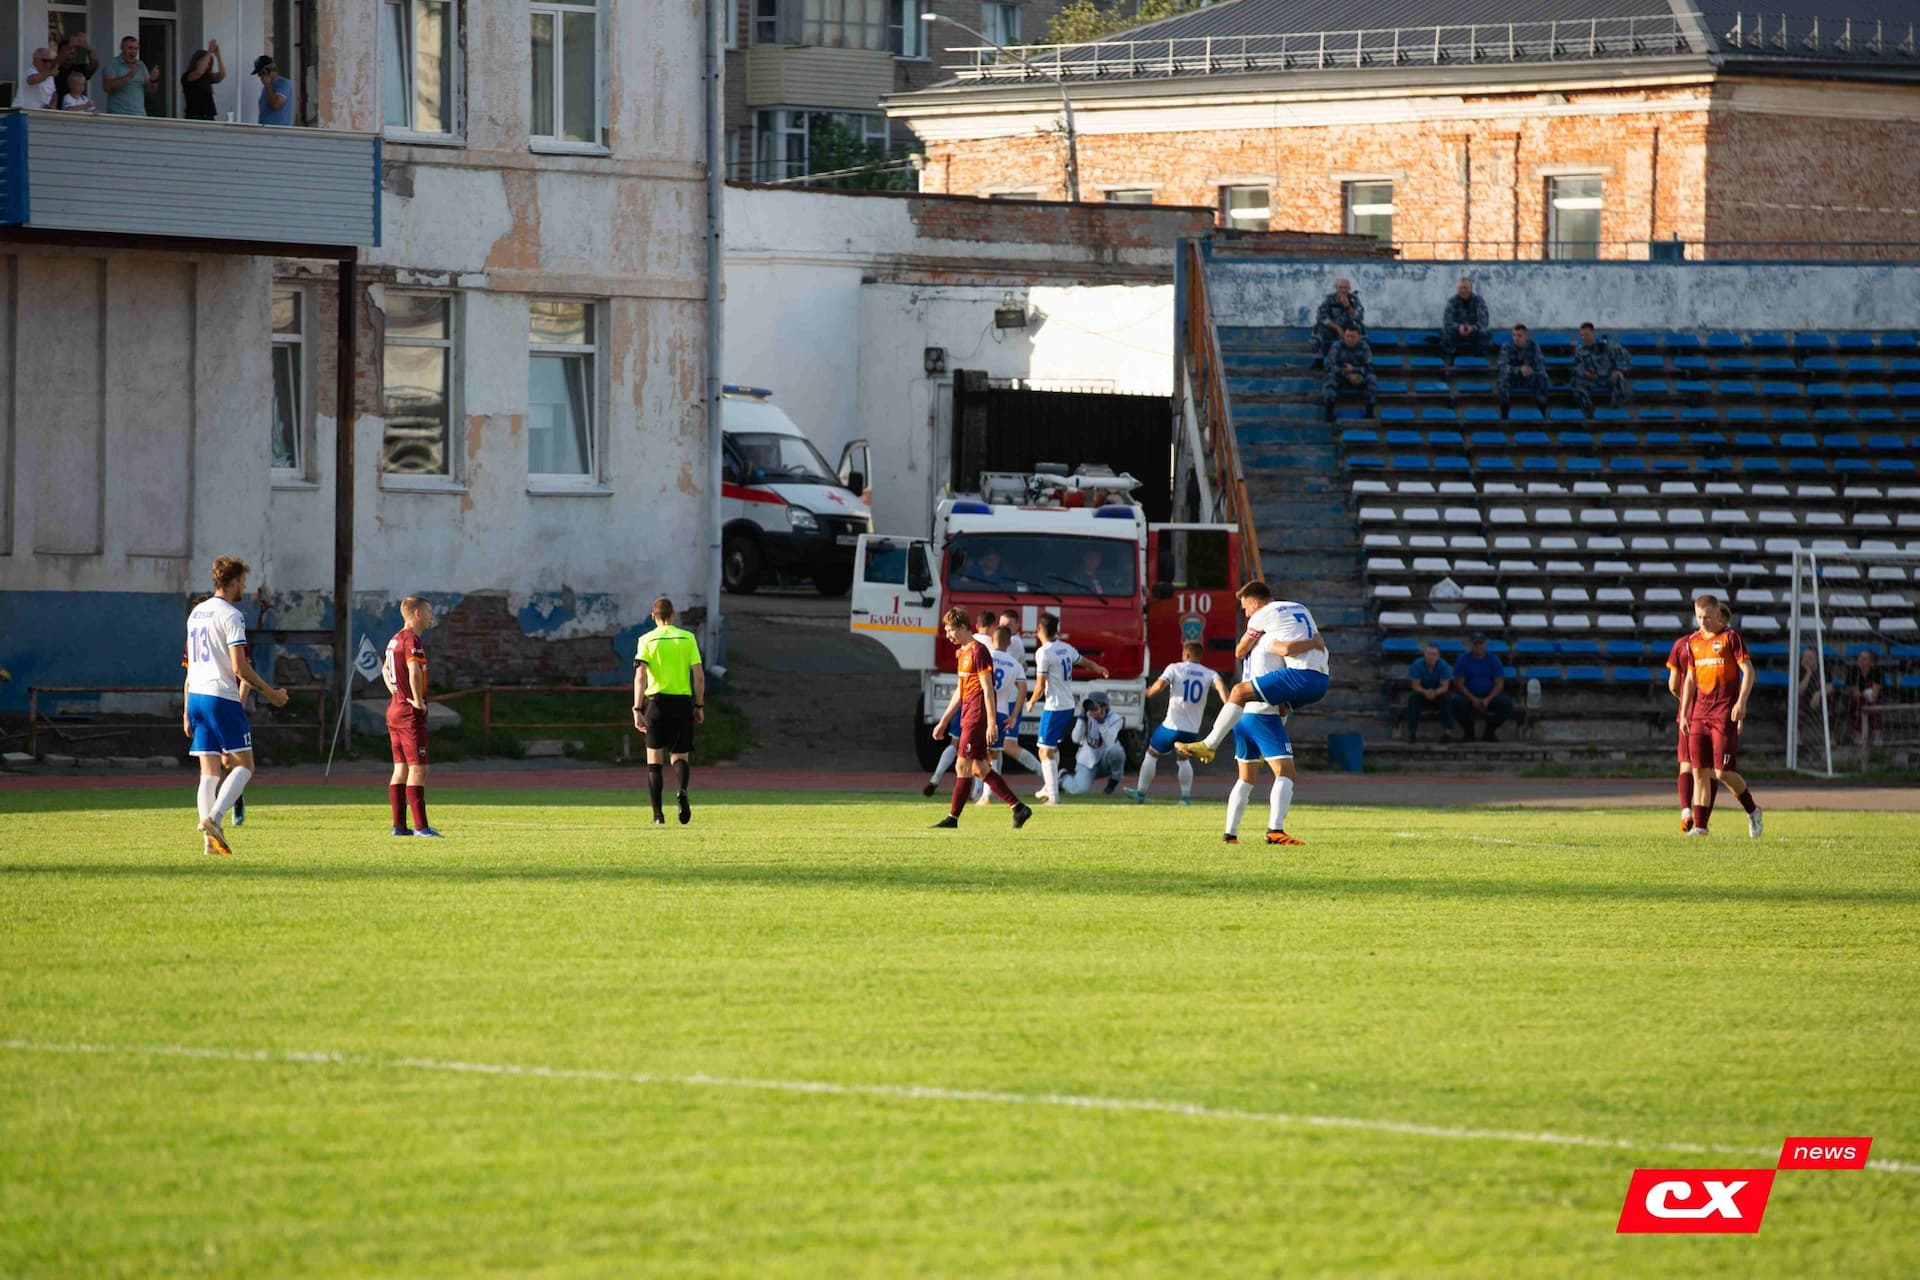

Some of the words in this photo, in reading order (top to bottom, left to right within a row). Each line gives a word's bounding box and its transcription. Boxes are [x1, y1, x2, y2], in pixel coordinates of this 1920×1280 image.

[894, 596, 899, 614] 1
[1177, 593, 1211, 613] 110
[870, 614, 922, 627] БАРНАУЛ
[1293, 613, 1312, 638] 7
[190, 626, 210, 662] 13
[1183, 679, 1203, 704] 10
